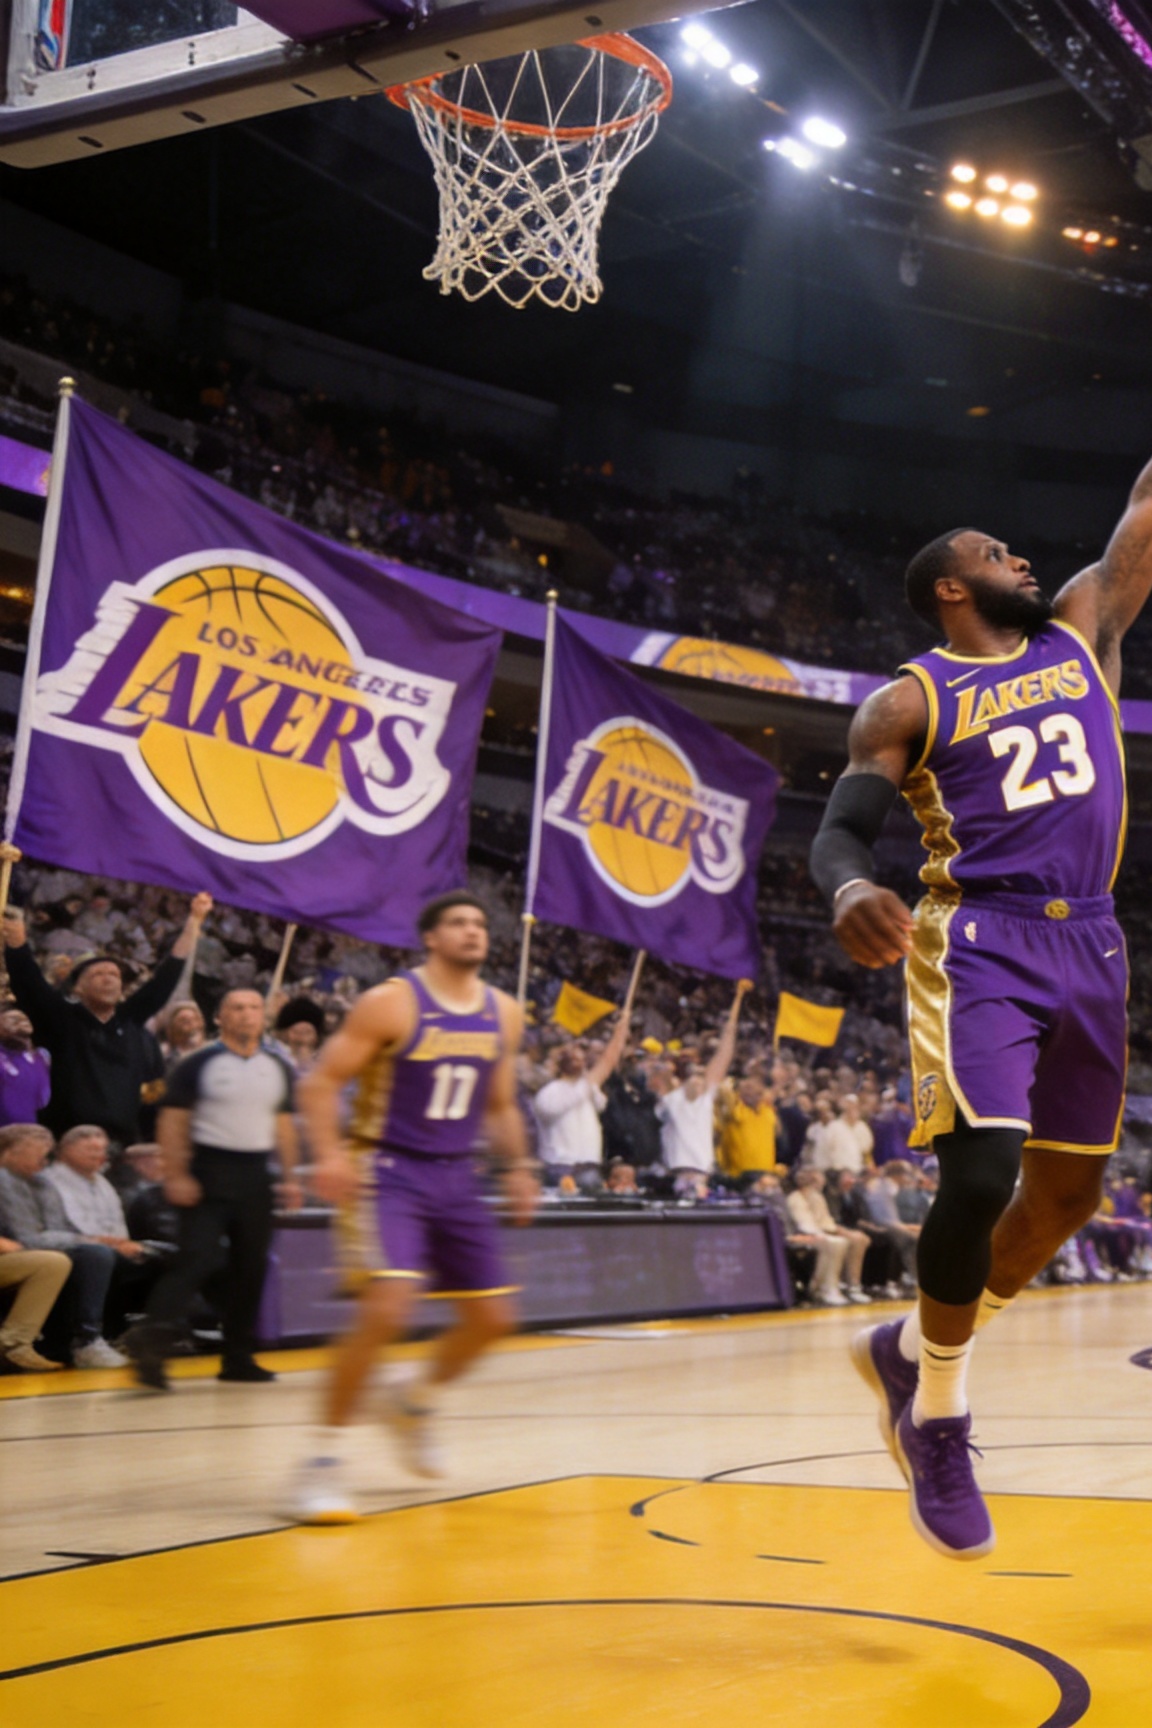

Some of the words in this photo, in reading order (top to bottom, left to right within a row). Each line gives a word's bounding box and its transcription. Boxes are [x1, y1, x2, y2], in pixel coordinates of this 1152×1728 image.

[197, 621, 259, 658] LOS
[49, 597, 430, 819] LAKERS
[948, 658, 1090, 747] LAKERS
[987, 712, 1096, 813] 23
[557, 748, 741, 883] LAKERS
